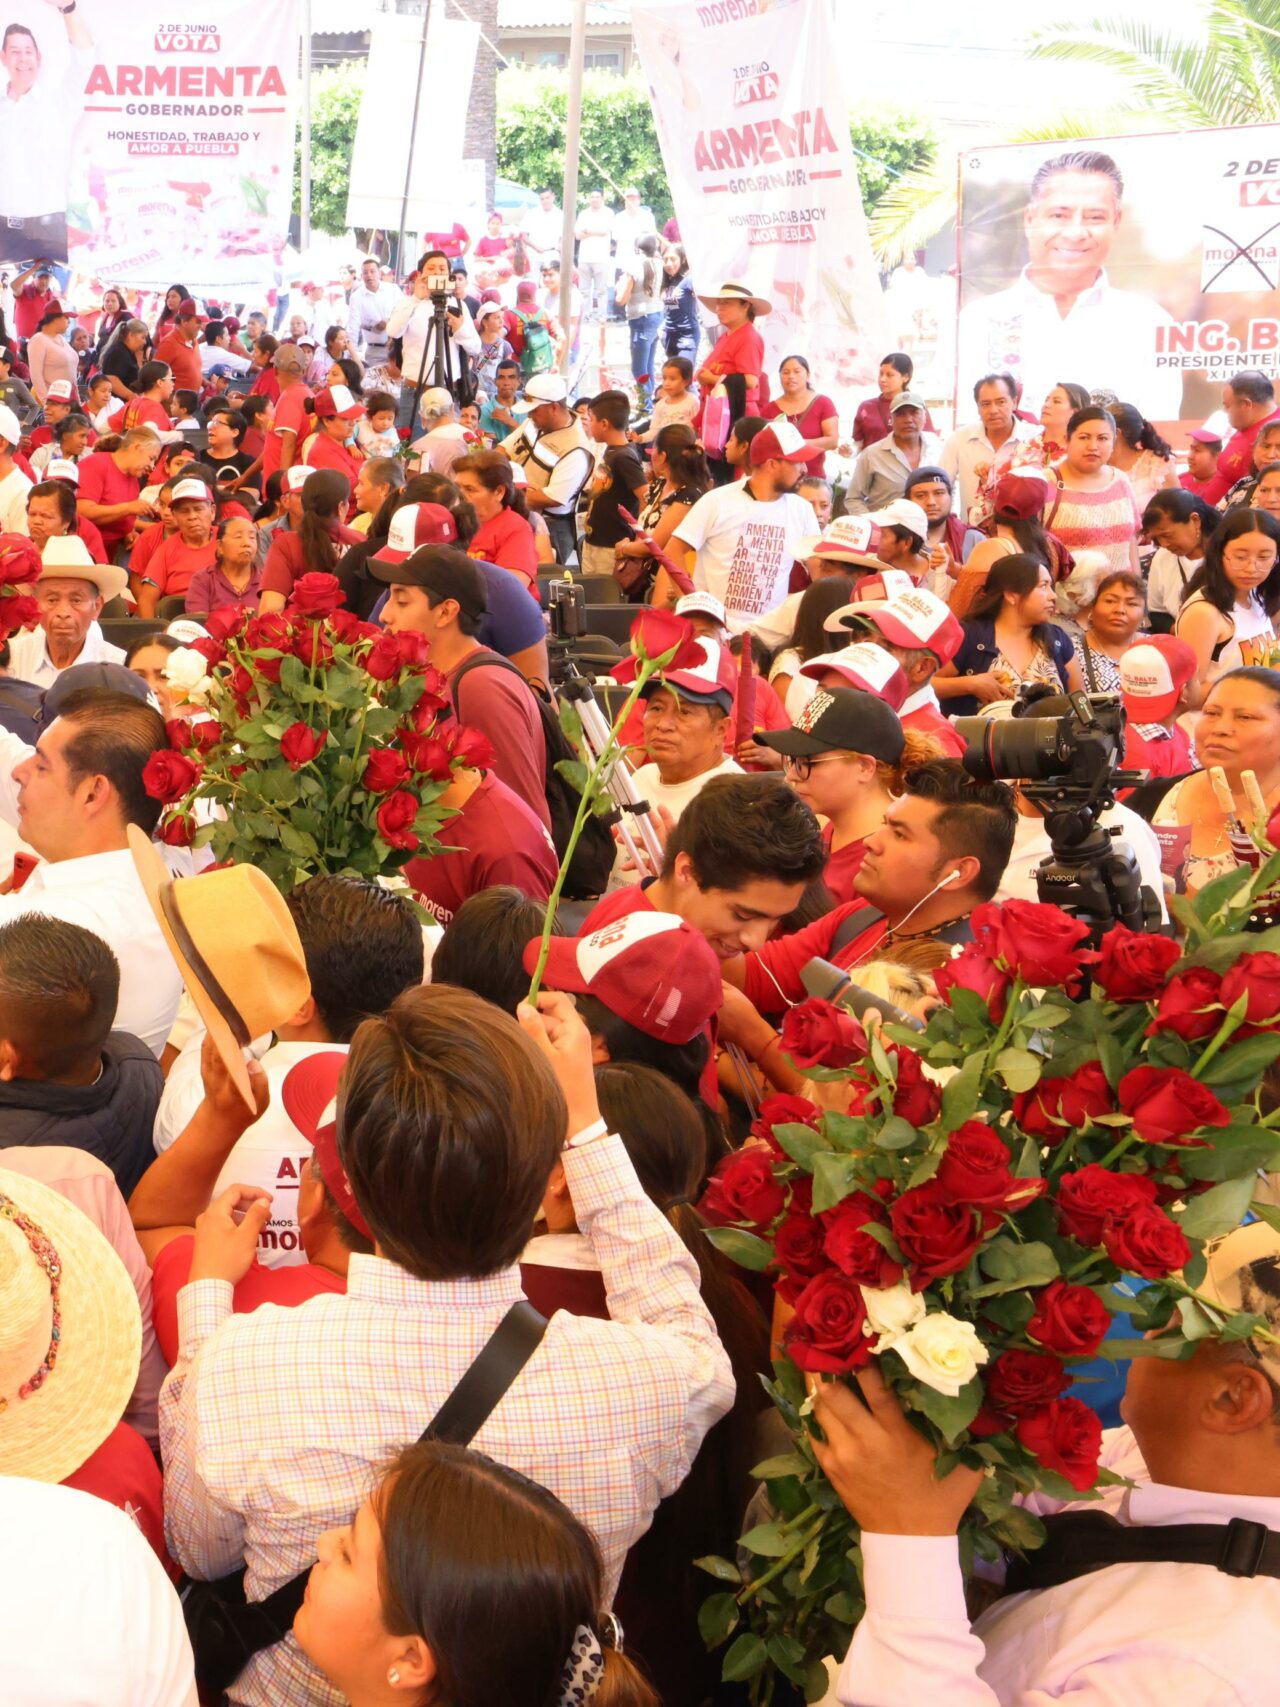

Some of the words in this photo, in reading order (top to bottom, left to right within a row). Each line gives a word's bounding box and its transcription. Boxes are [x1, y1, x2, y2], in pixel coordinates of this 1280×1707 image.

[158, 24, 165, 33] 2
[168, 24, 182, 33] DE
[185, 24, 218, 33] JUNIO
[156, 35, 219, 50] VOTA
[84, 64, 287, 97] ARMENTA
[126, 103, 244, 116] GOBERNADOR
[107, 131, 189, 142] HONESTIDAD,
[193, 132, 249, 141] TRABAJO
[252, 132, 261, 141] Y
[695, 107, 839, 171] ARMENTA
[131, 144, 169, 154] AMOR
[172, 144, 182, 154] A
[186, 144, 237, 154] PUEBLA
[1223, 162, 1239, 177] 2
[1155, 324, 1240, 353] ING.
[1156, 354, 1270, 368] PRESIDENTE
[1045, 873, 1076, 882] Andoer
[419, 892, 454, 922] moren
[266, 1219, 294, 1228] AMOS
